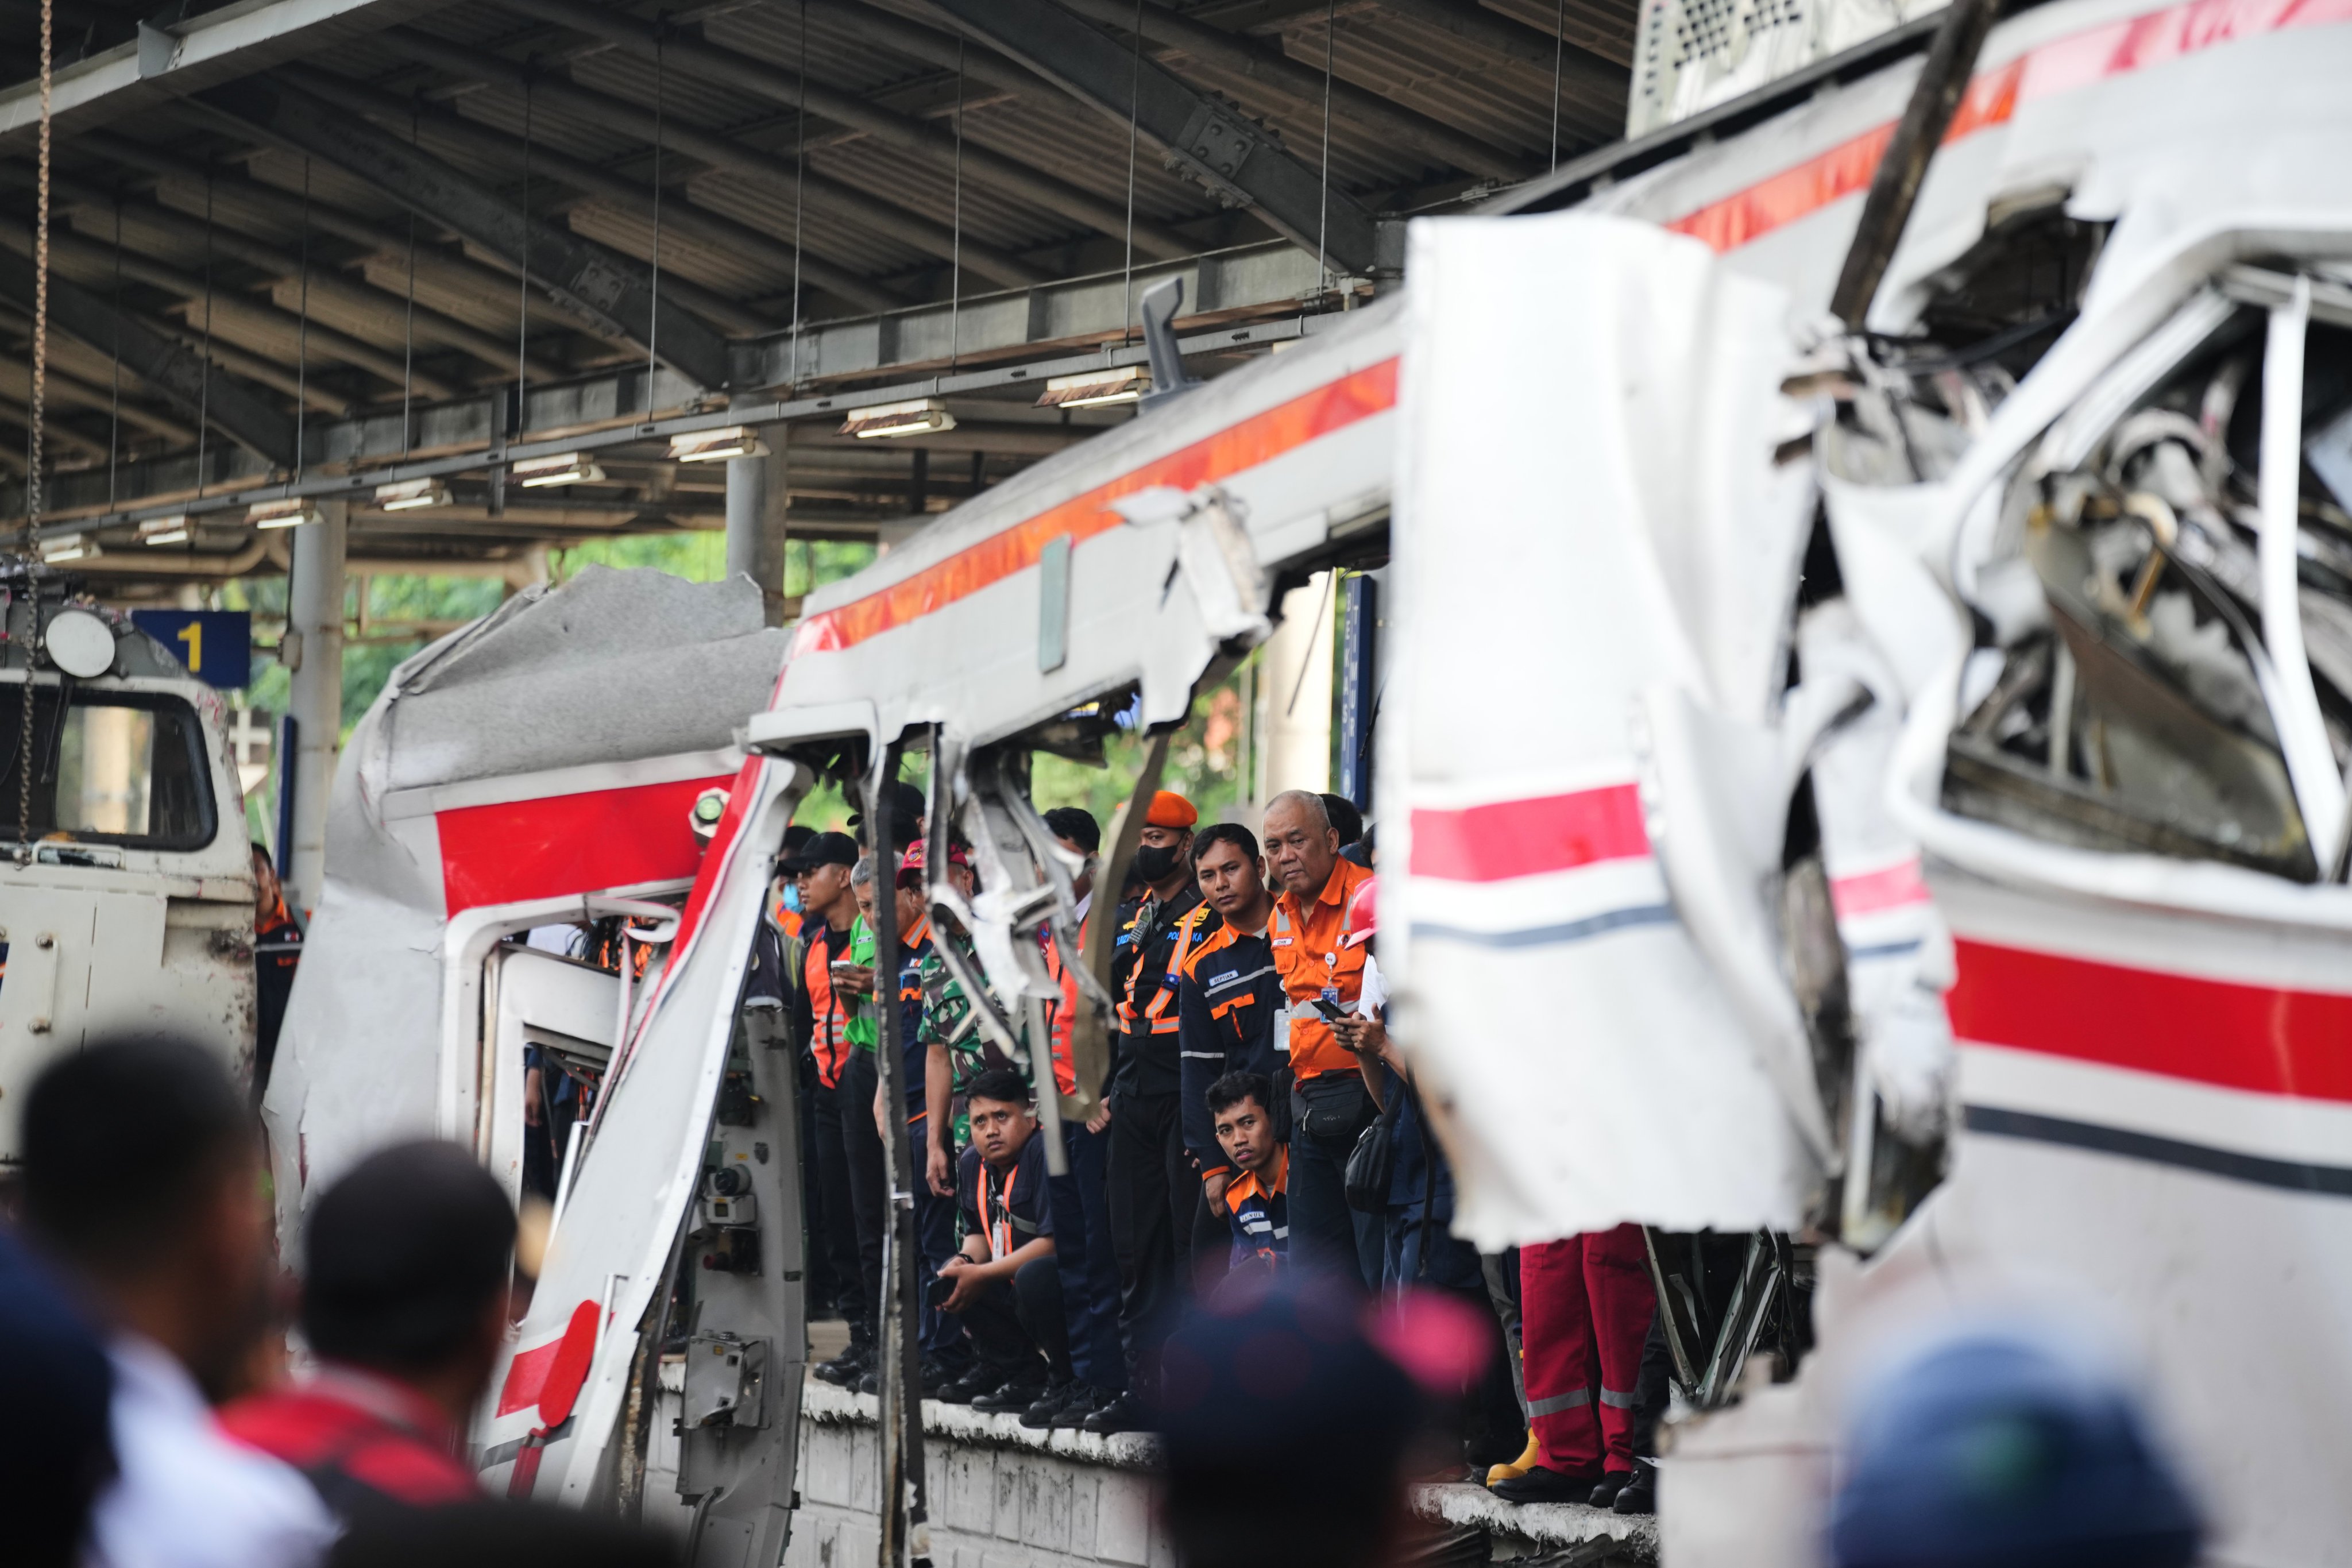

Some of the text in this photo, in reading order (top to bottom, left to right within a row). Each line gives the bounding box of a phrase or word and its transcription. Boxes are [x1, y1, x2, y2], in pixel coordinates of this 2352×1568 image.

[177, 621, 201, 672] 1
[1342, 592, 1351, 751] BEKASI
[1349, 605, 1359, 738] TIMUR
[1214, 973, 1233, 983] SEPTIAN
